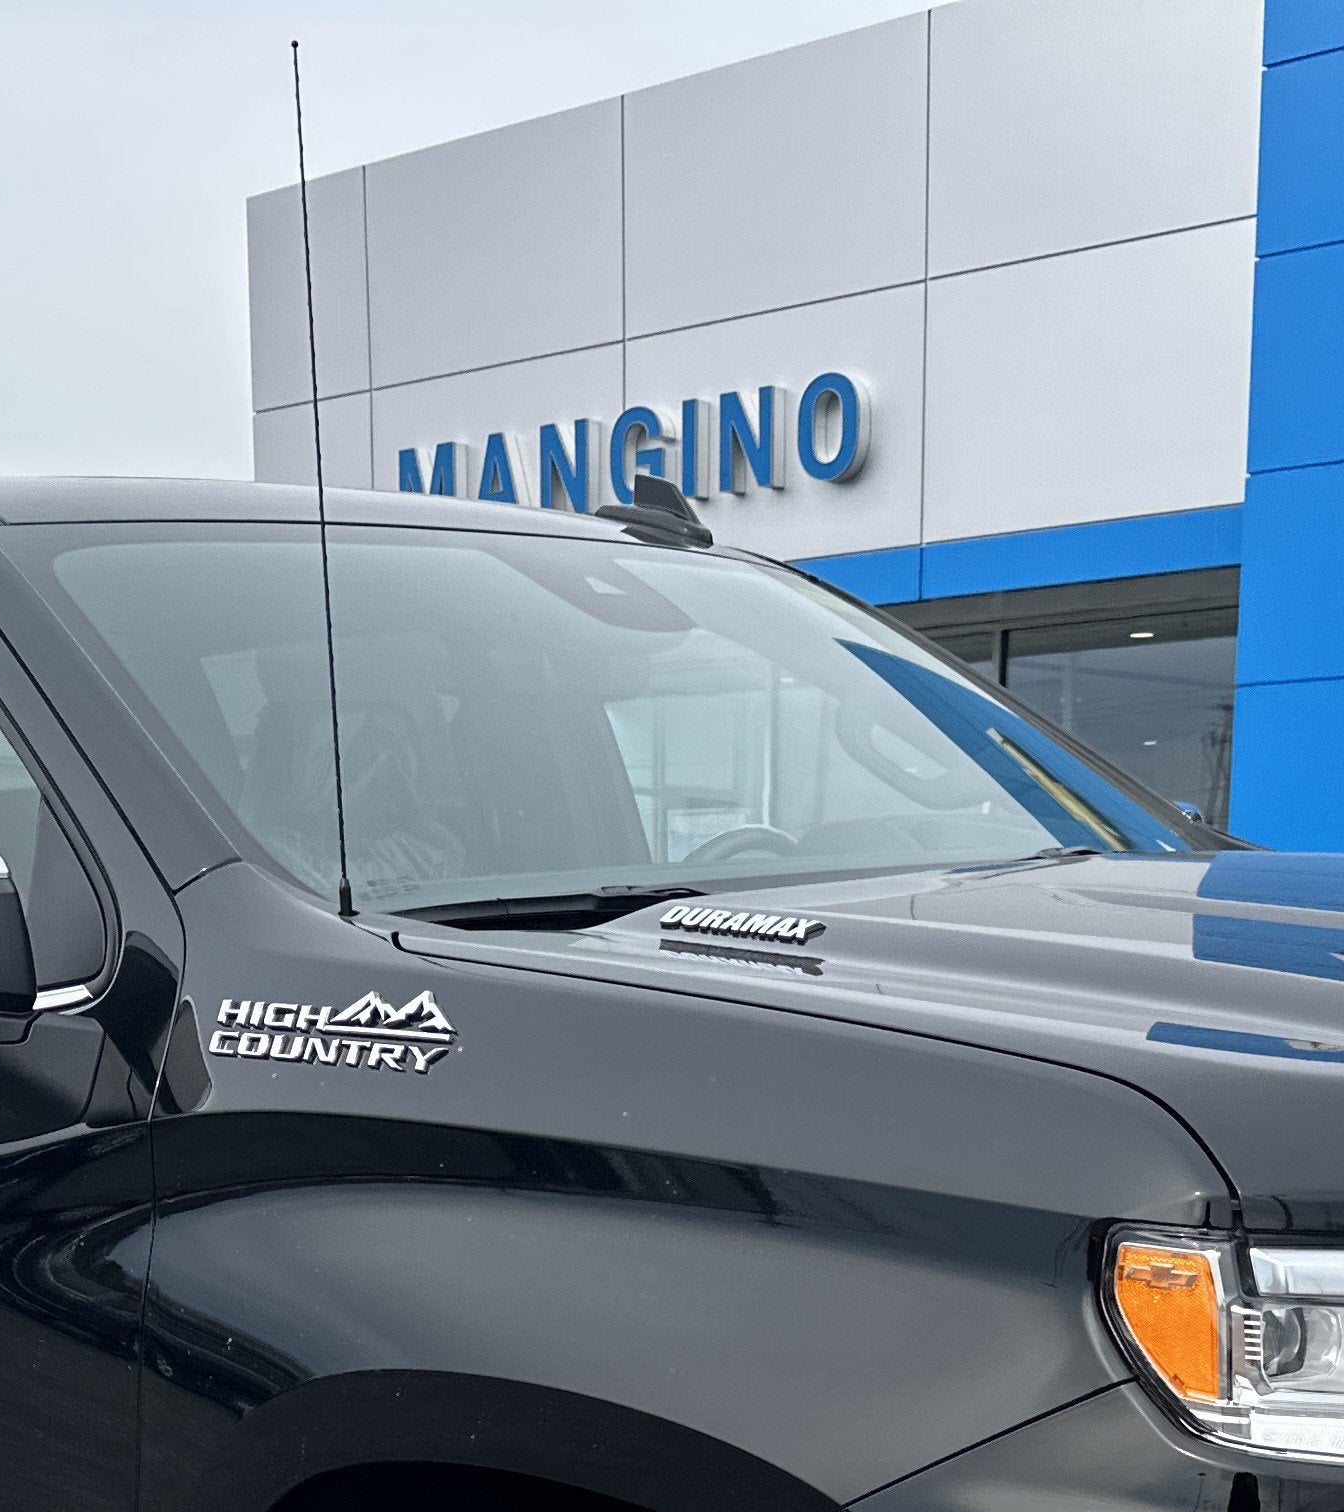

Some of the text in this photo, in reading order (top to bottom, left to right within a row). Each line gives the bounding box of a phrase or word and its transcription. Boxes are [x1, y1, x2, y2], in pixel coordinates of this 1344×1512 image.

[398, 371, 866, 514] MANGINO
[659, 904, 826, 946] DURAMAX
[216, 998, 333, 1033] HIGH
[208, 1030, 451, 1074] COUNTRY
